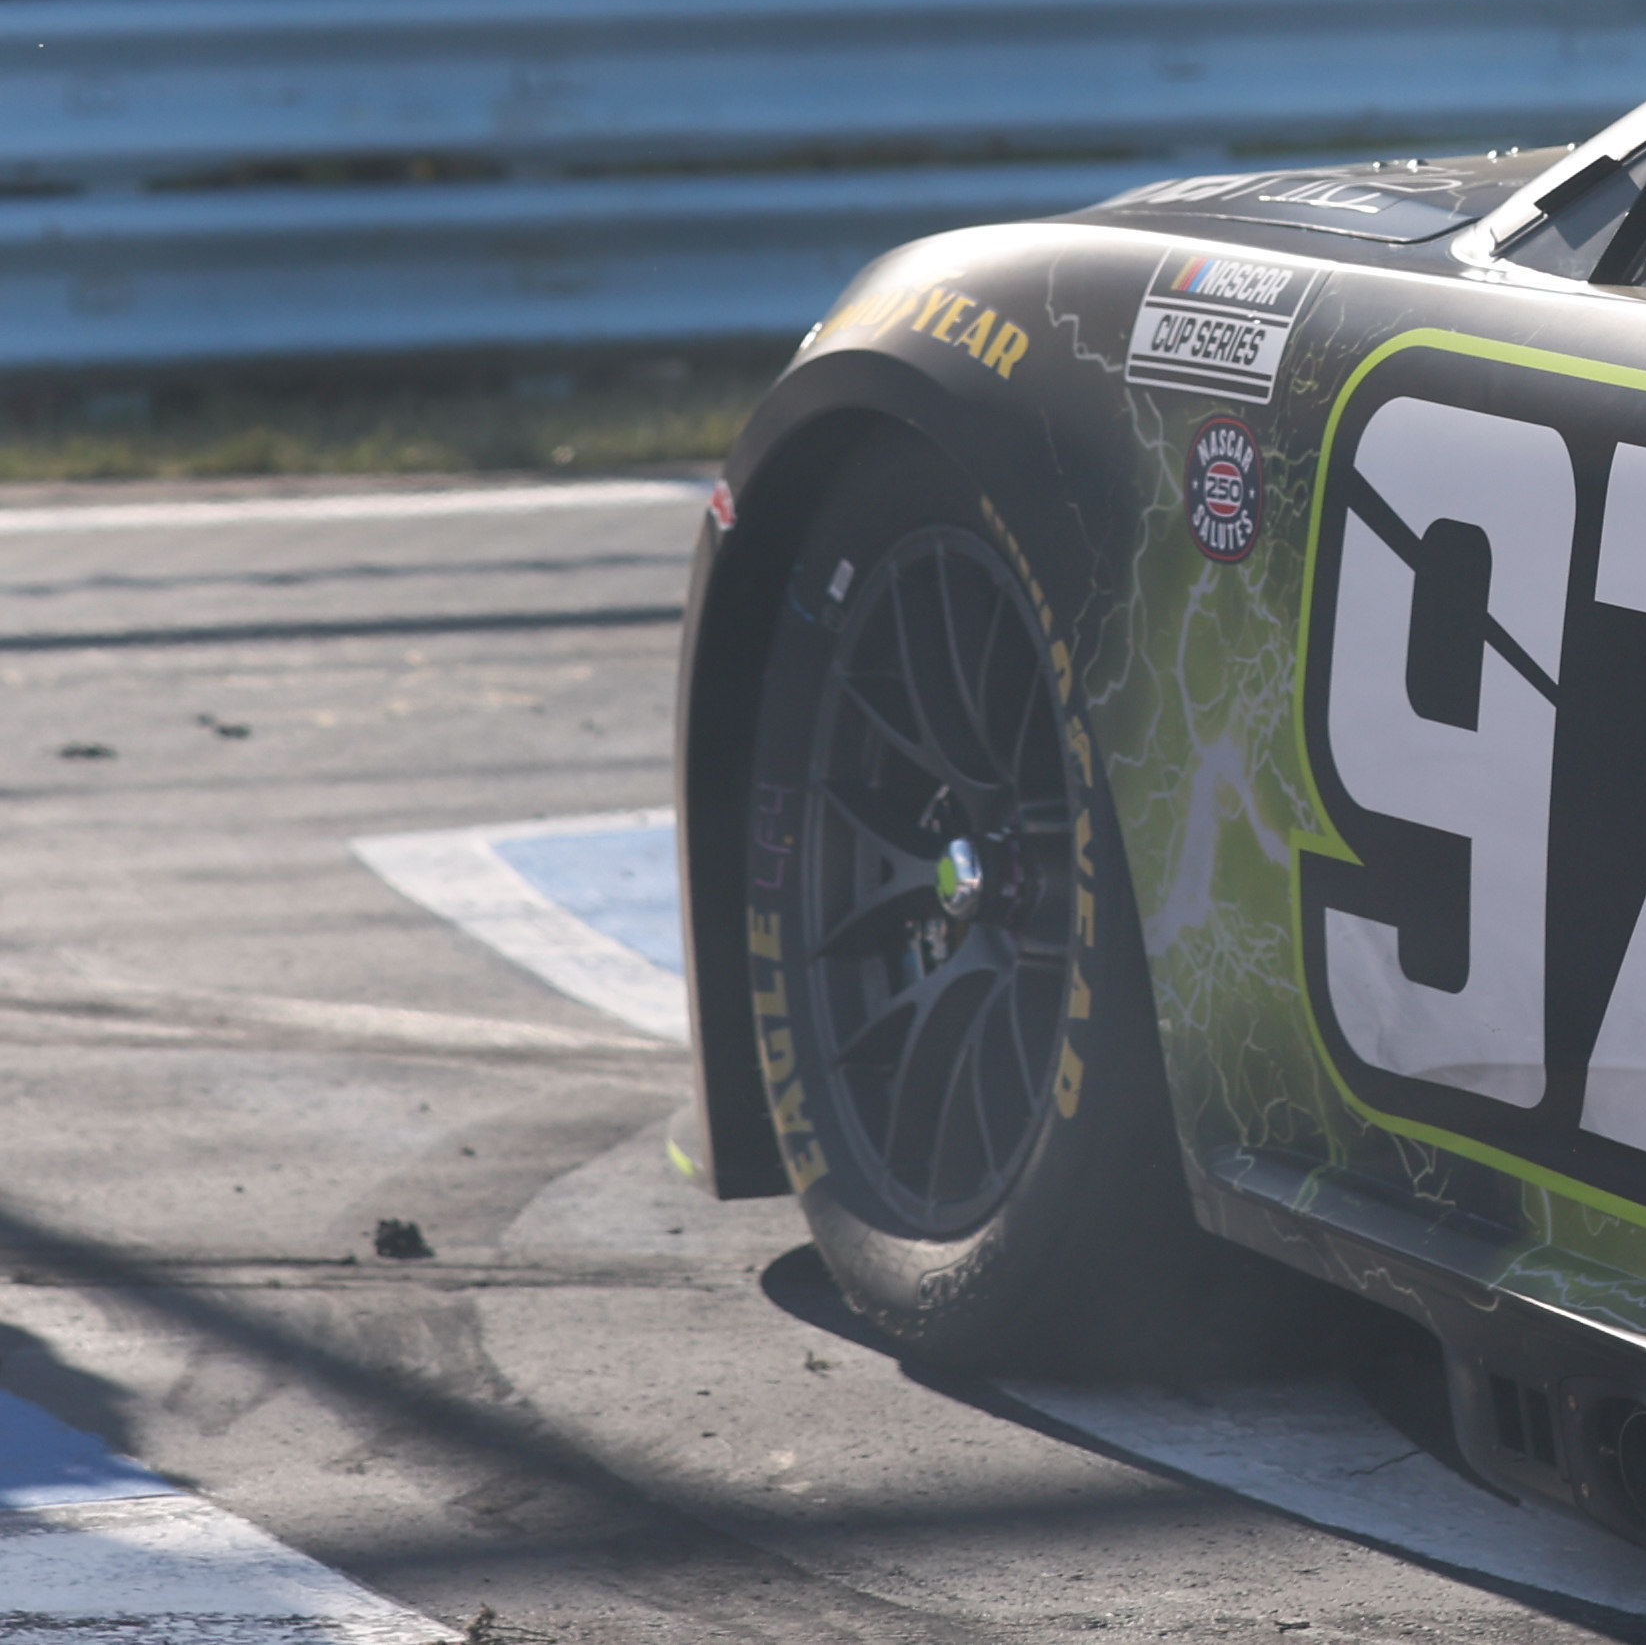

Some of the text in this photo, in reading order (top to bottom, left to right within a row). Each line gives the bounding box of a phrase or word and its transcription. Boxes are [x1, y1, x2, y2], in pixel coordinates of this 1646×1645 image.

[1197, 259, 1294, 306] NASCAR
[1151, 314, 1266, 366] CUP SERIES
[1197, 429, 1254, 473] NASCAR
[1206, 475, 1243, 503] 250
[1192, 503, 1253, 551] SALUTES
[747, 905, 831, 1197] EAGLE
